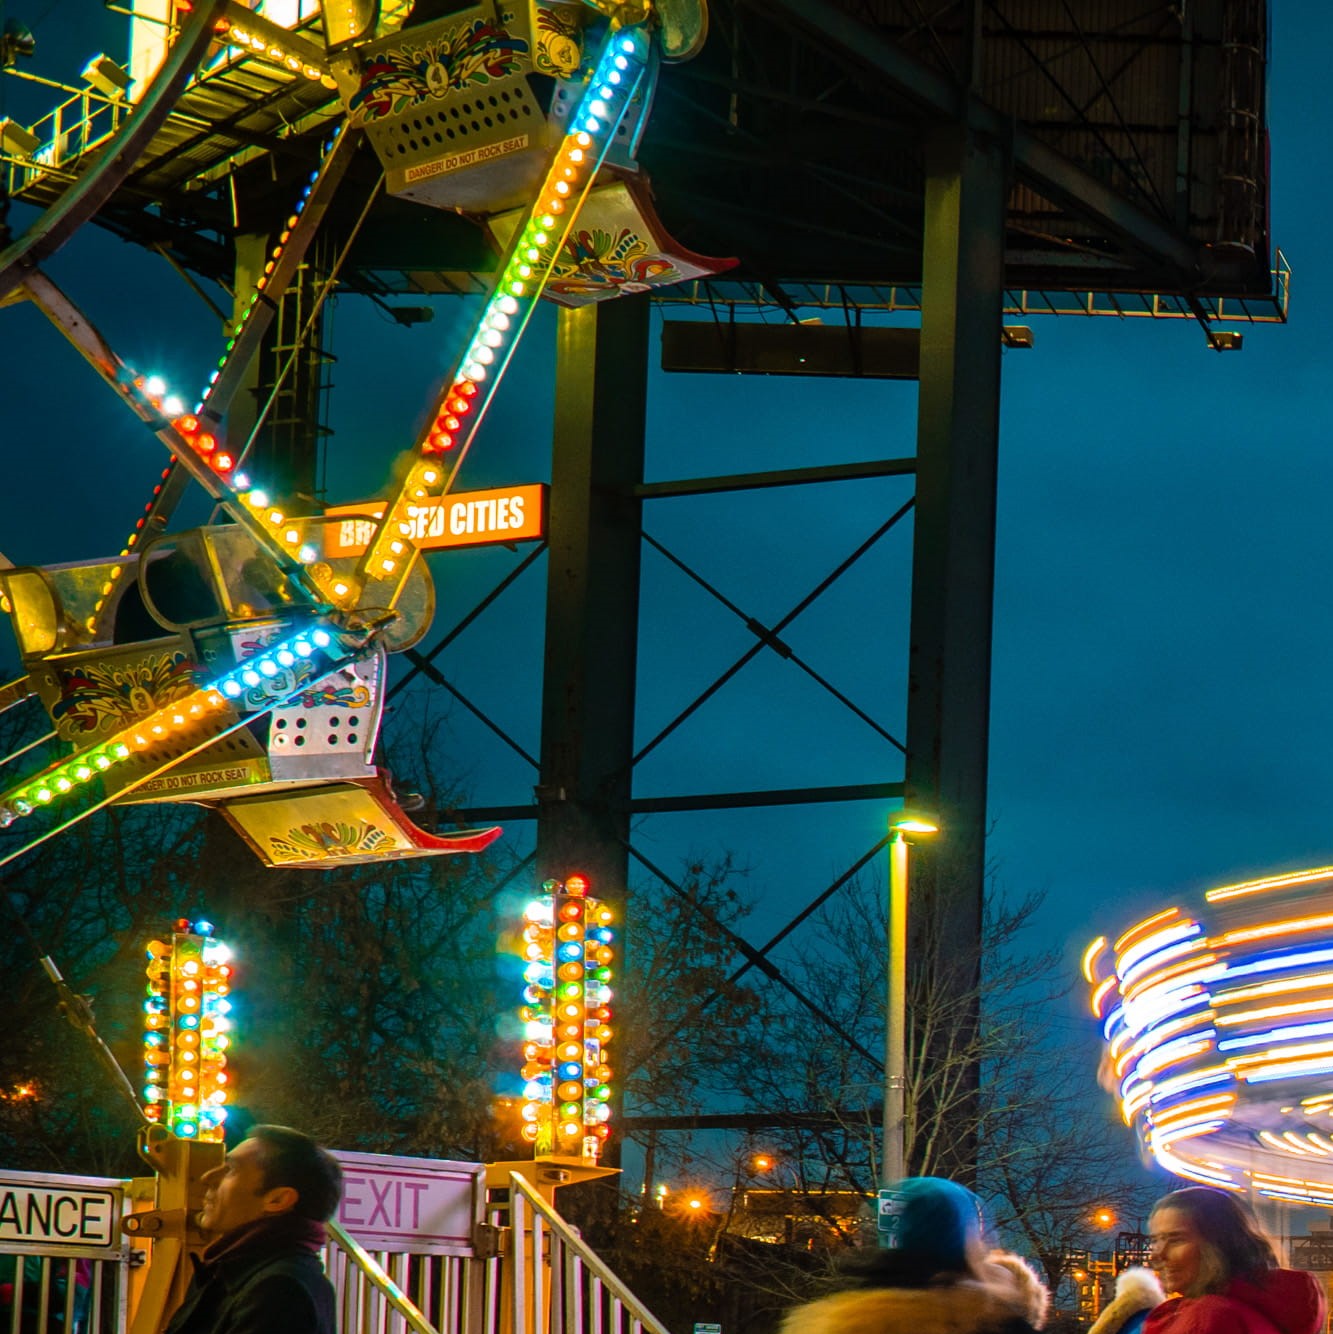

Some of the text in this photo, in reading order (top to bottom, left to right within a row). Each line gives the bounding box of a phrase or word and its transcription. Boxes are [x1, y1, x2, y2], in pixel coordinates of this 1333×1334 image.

[408, 137, 525, 180] DANGER! DO NOT ROCK SEAT
[450, 496, 525, 535] CITIES
[167, 777, 179, 789] DO
[181, 774, 198, 787] NOT
[200, 771, 224, 785] ROCK
[225, 768, 247, 781] SEAT
[339, 1177, 429, 1230] EXIT
